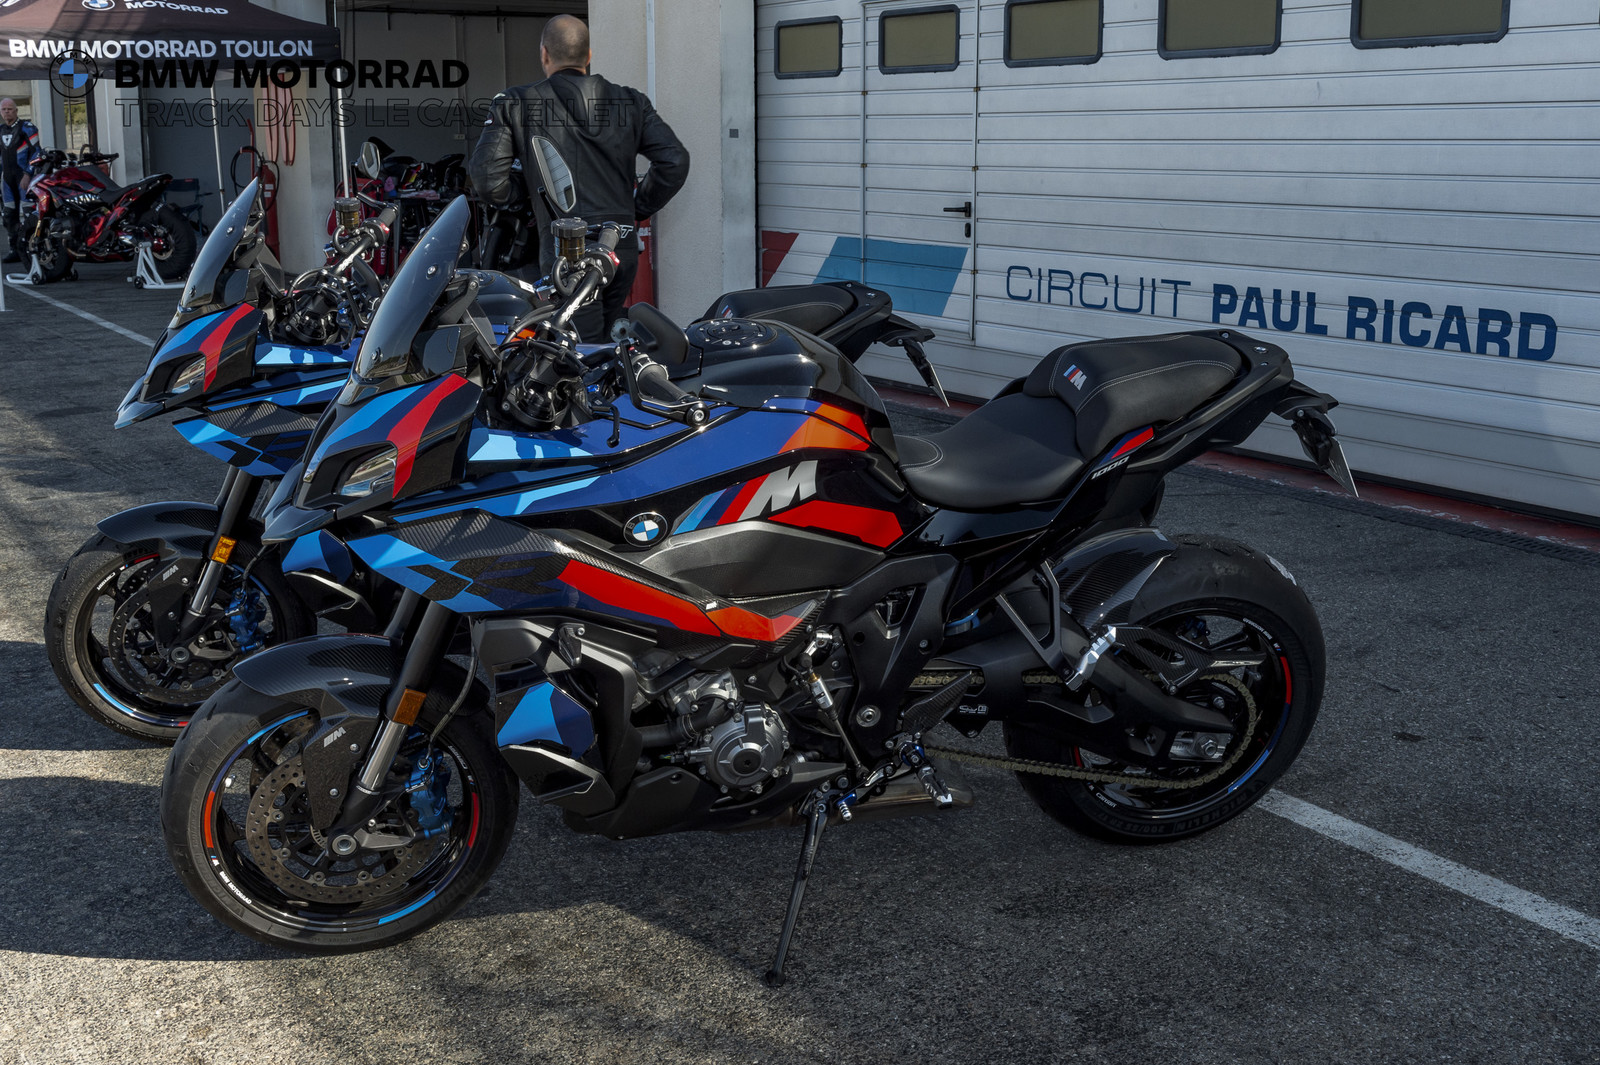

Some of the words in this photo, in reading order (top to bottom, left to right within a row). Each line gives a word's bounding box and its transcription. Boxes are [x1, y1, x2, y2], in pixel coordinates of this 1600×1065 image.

[126, 1, 229, 15] MOTORRAD
[9, 39, 75, 58] BMW
[80, 39, 217, 58] MOTORRAD
[220, 40, 313, 57] TOULON
[1006, 265, 1191, 318] CIRCUIT
[1212, 284, 1328, 335] PAUL
[1346, 295, 1557, 361] RICARD
[1091, 456, 1130, 480] 1000
[1175, 792, 1246, 832] MICHELIN
